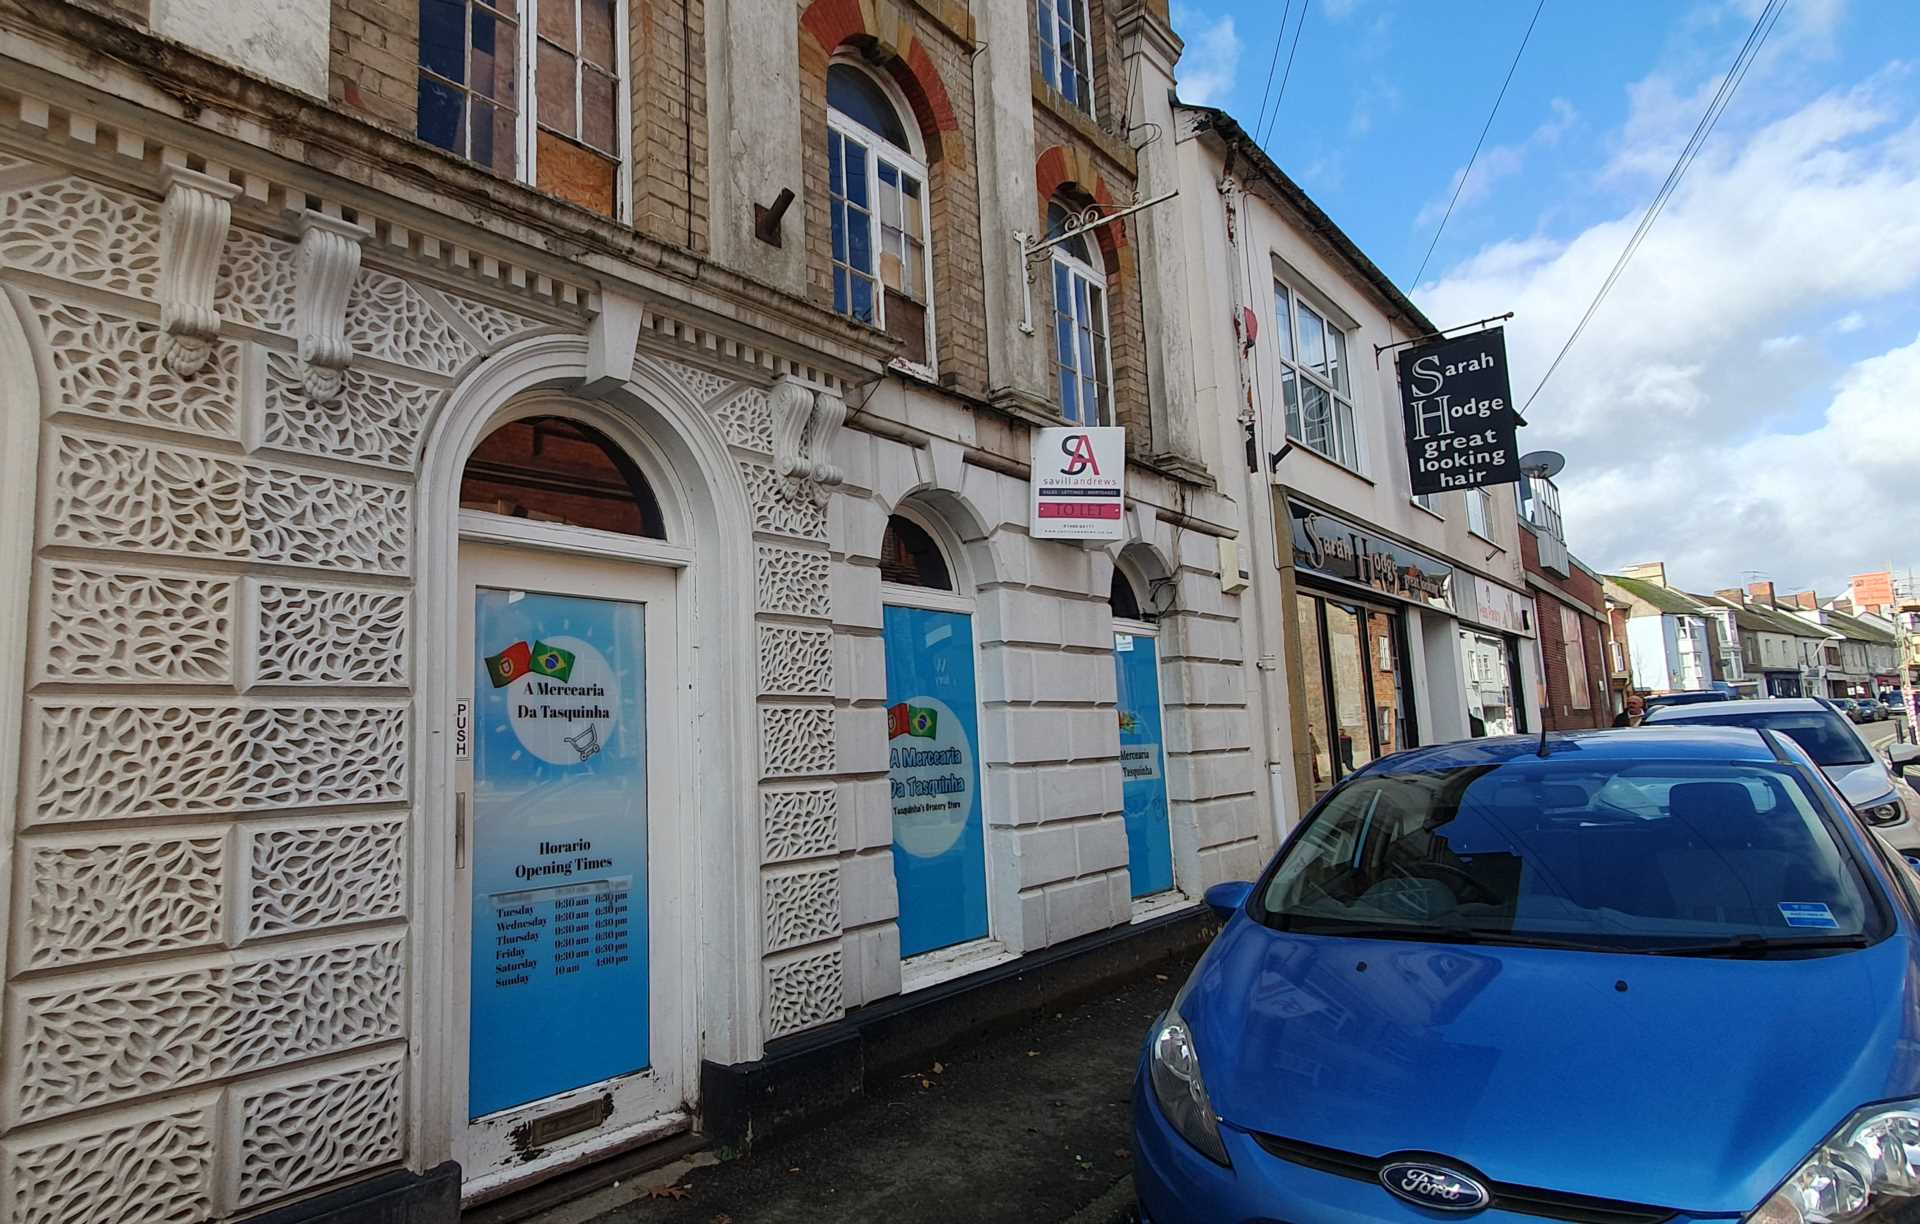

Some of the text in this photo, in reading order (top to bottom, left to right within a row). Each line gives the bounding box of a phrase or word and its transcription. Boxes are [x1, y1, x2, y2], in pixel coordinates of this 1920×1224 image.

[1411, 353, 1495, 398] Sarah
[1410, 395, 1504, 440] Hodge
[1424, 429, 1497, 459] great
[1419, 450, 1506, 473] looking
[1440, 469, 1487, 488] hair
[1056, 504, 1104, 516] TO LET
[524, 682, 605, 697] A Mercearia
[517, 705, 610, 722] Da Tasquinha
[456, 704, 466, 755] PUSH
[890, 746, 962, 768] A Mercearia
[906, 773, 965, 798] Tasquinha
[539, 838, 591, 855] Horario
[515, 856, 613, 880] Opening Times
[496, 904, 534, 918] Tuesday
[575, 898, 589, 906] am
[615, 893, 627, 901] pm
[496, 917, 547, 931] Wednesday
[575, 911, 589, 919] am
[615, 905, 627, 914] pm
[496, 931, 539, 946] Thursday
[575, 924, 589, 932] am
[615, 918, 627, 927] pm
[496, 947, 525, 960] Friday
[575, 937, 589, 945] am
[615, 930, 627, 939] pm
[496, 958, 537, 974] Saturday
[575, 950, 589, 958] am
[615, 943, 627, 951] pm
[496, 974, 529, 988] Sunday
[615, 955, 628, 965] pm
[1401, 1169, 1460, 1200] Ford
